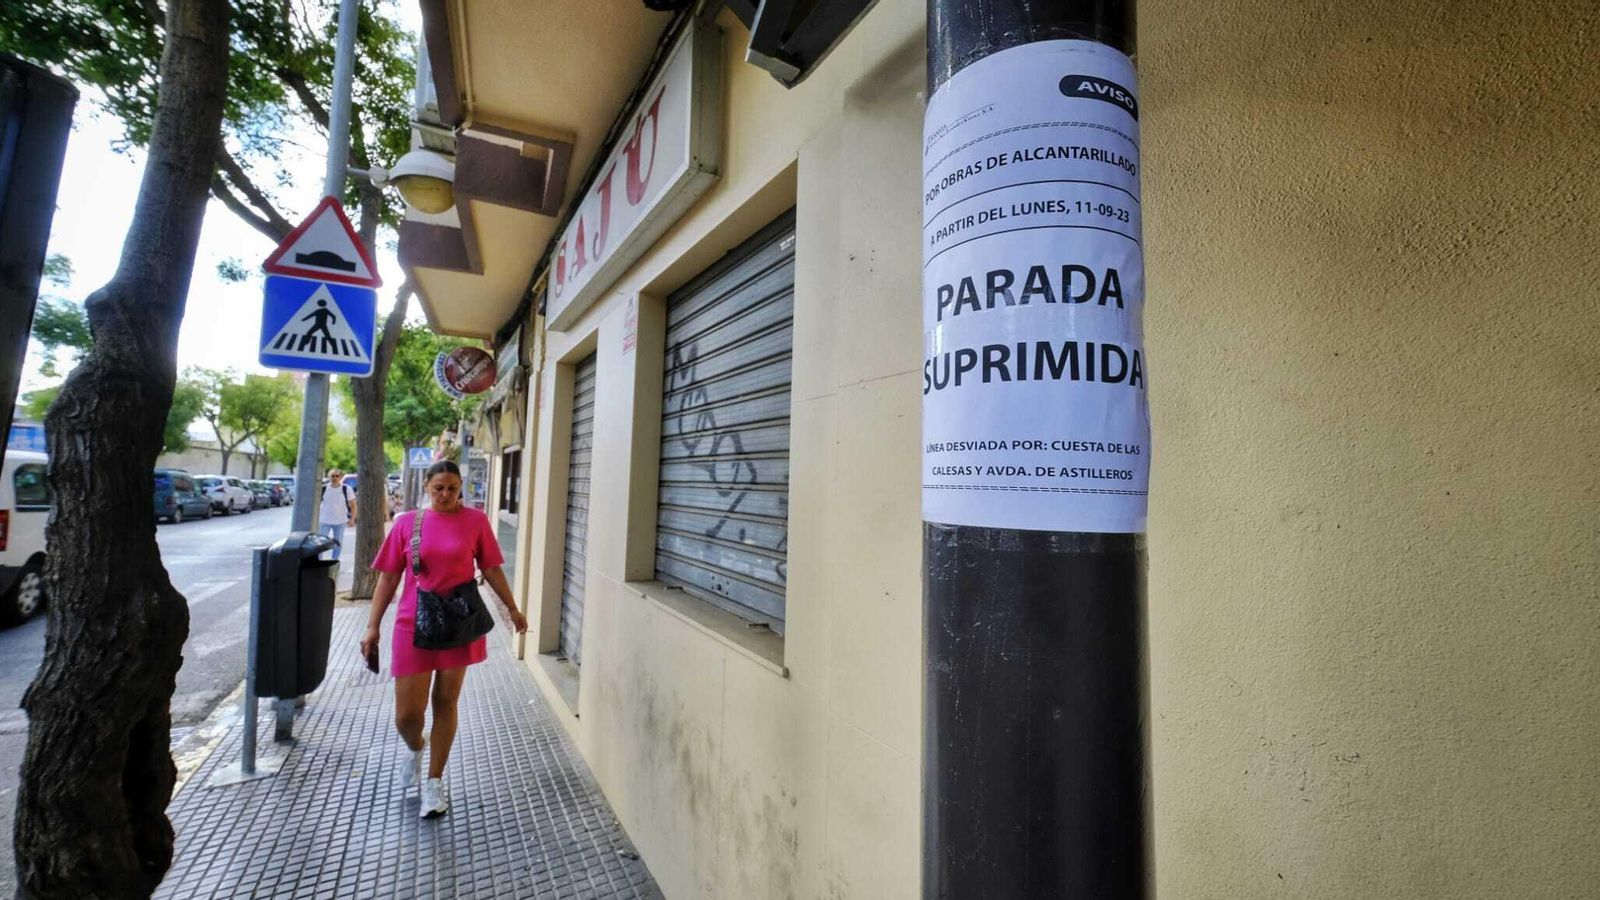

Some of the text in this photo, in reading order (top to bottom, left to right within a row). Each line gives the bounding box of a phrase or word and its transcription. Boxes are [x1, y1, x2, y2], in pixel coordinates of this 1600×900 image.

[1077, 80, 1135, 110] AVISO
[925, 146, 1136, 205] POR OBRAS DE ALCANTARILLADO
[930, 200, 1130, 246] A PARTIR DEL LUNES, 11-09-23
[937, 264, 1124, 321] PARADA
[923, 341, 1144, 396] SUPRIMIDA
[946, 440, 1008, 452] DESVIADA
[1012, 441, 1048, 451] POR:
[1051, 440, 1105, 453] CUESTA
[1108, 443, 1123, 454] DE
[1125, 444, 1141, 455] LAS
[932, 465, 1133, 480] CALESAS Y AVDA. DE ASTILLEROS
